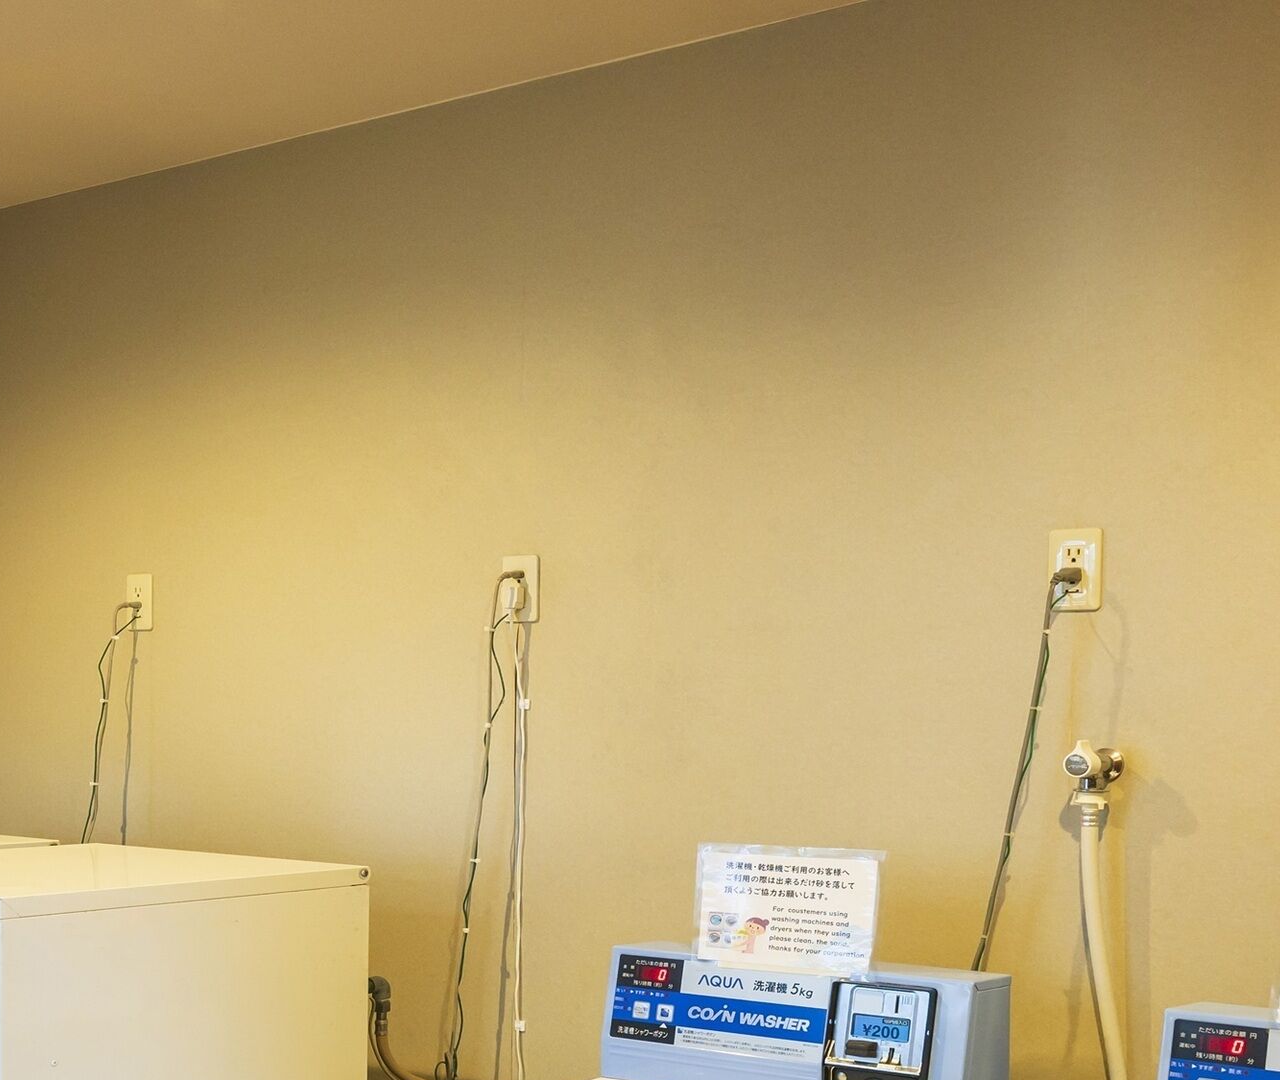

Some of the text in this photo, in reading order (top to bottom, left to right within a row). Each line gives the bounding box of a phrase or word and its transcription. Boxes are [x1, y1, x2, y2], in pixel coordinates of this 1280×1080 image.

[829, 911, 848, 919] using
[771, 916, 800, 924] washing
[802, 918, 834, 926] machines
[770, 925, 792, 933] dryers
[769, 935, 792, 943] please
[658, 969, 667, 980] 0
[698, 974, 813, 999] AQUA 洗濯機 5kg
[740, 1012, 810, 1032] WASHER
[863, 1023, 900, 1040] ¥200
[1232, 1040, 1244, 1053] 0
